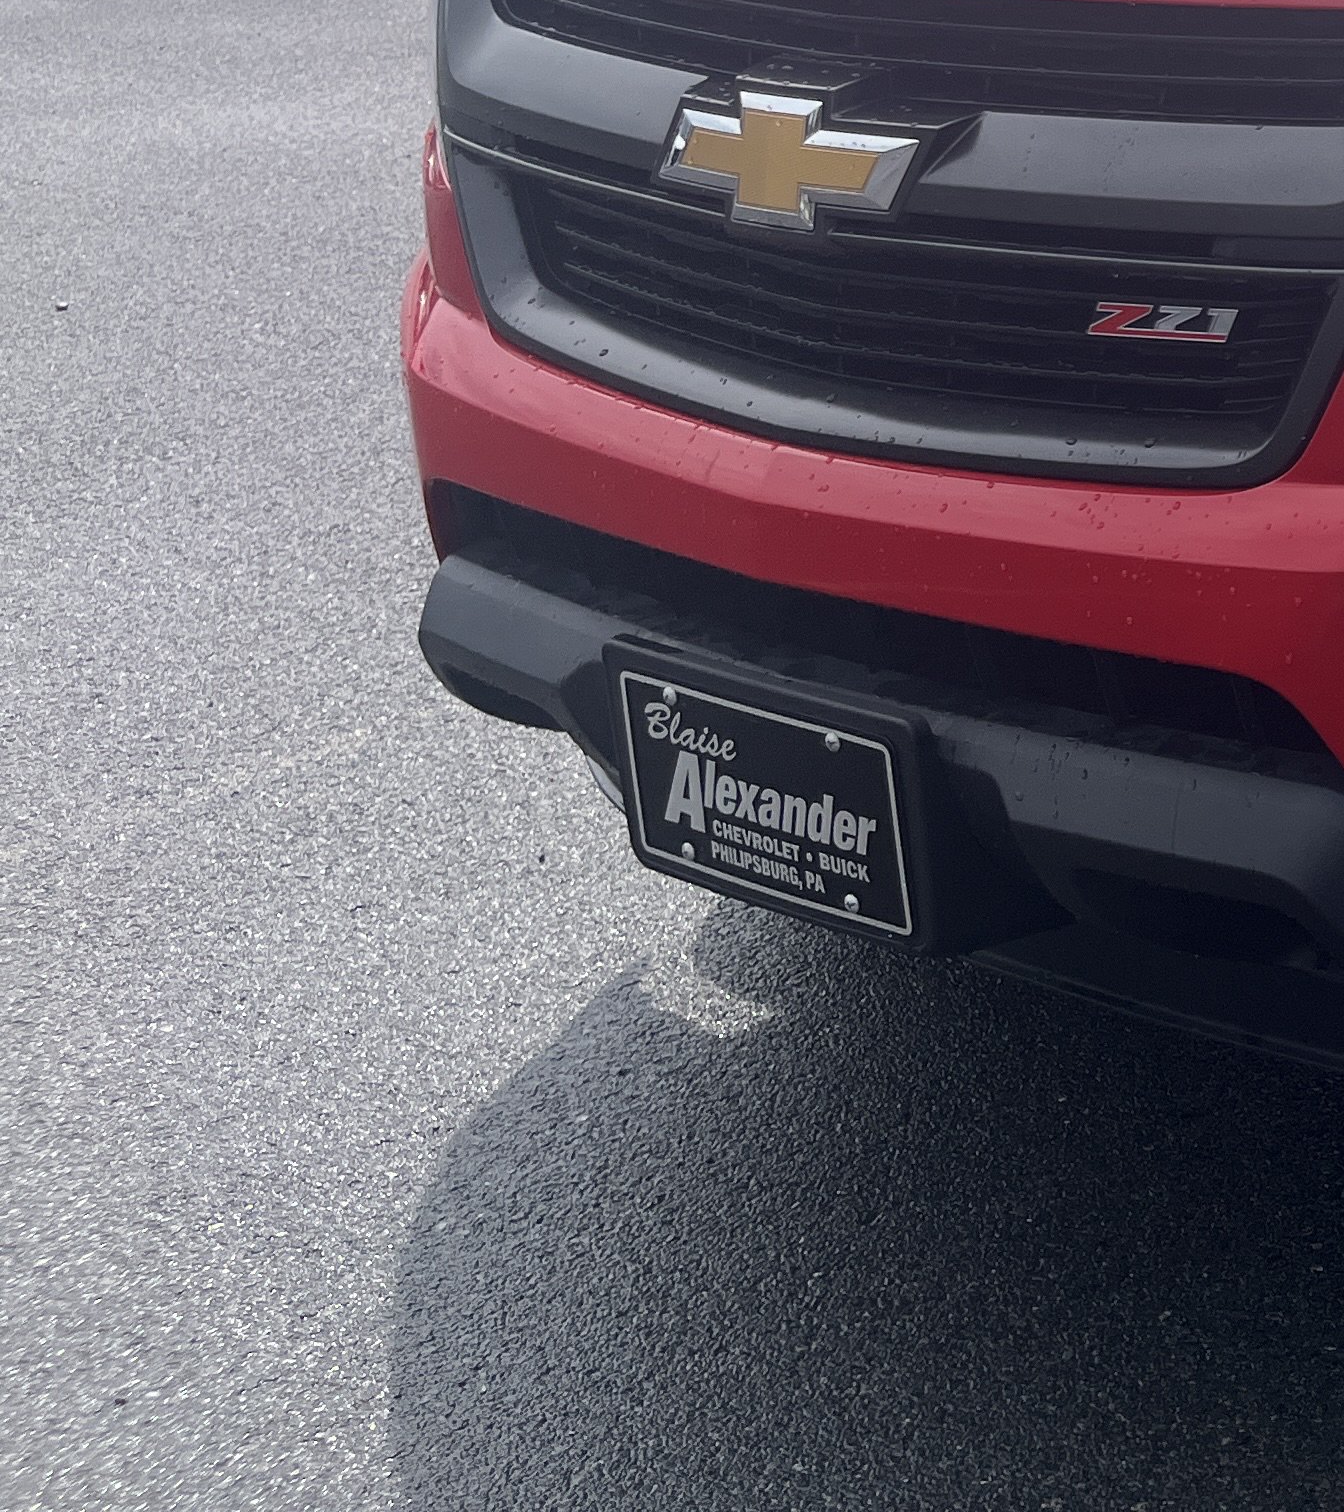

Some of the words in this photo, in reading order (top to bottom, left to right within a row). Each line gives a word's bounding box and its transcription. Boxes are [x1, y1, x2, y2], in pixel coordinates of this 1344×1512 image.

[1087, 301, 1239, 343] Z71
[645, 702, 737, 761] Blaise
[664, 750, 877, 855] Alexander
[712, 820, 800, 862] CHEVROLET
[819, 852, 871, 884] BUICK
[712, 841, 803, 891] PHILIPSBURG,
[805, 872, 826, 894] PA
